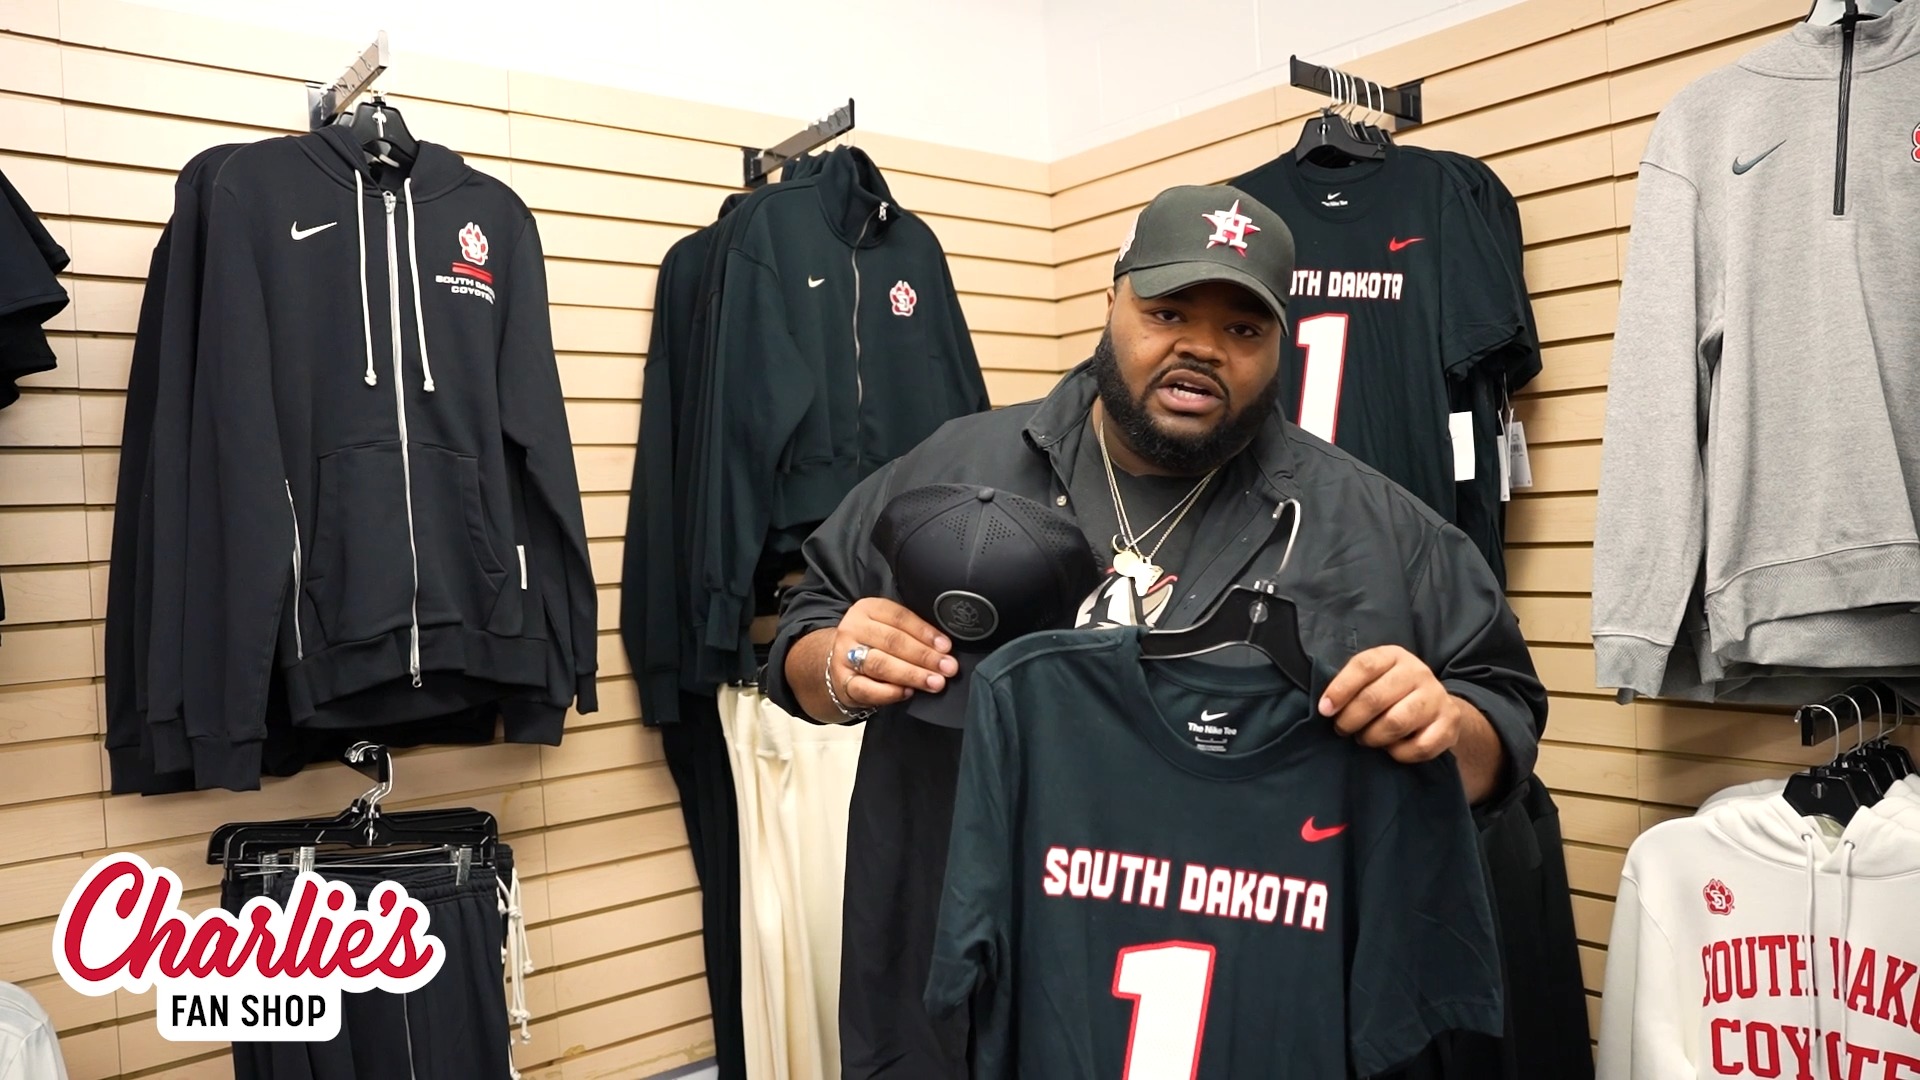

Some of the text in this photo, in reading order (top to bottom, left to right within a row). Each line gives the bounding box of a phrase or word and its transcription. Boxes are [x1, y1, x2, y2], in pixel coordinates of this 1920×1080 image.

[435, 274, 475, 286] SOUTH
[451, 285, 495, 305] COYOTE
[1326, 270, 1404, 300] DAKOTA
[1295, 311, 1350, 445] 1
[1043, 846, 1329, 932] SOUTH DAKOTA
[1111, 940, 1217, 1080] 1
